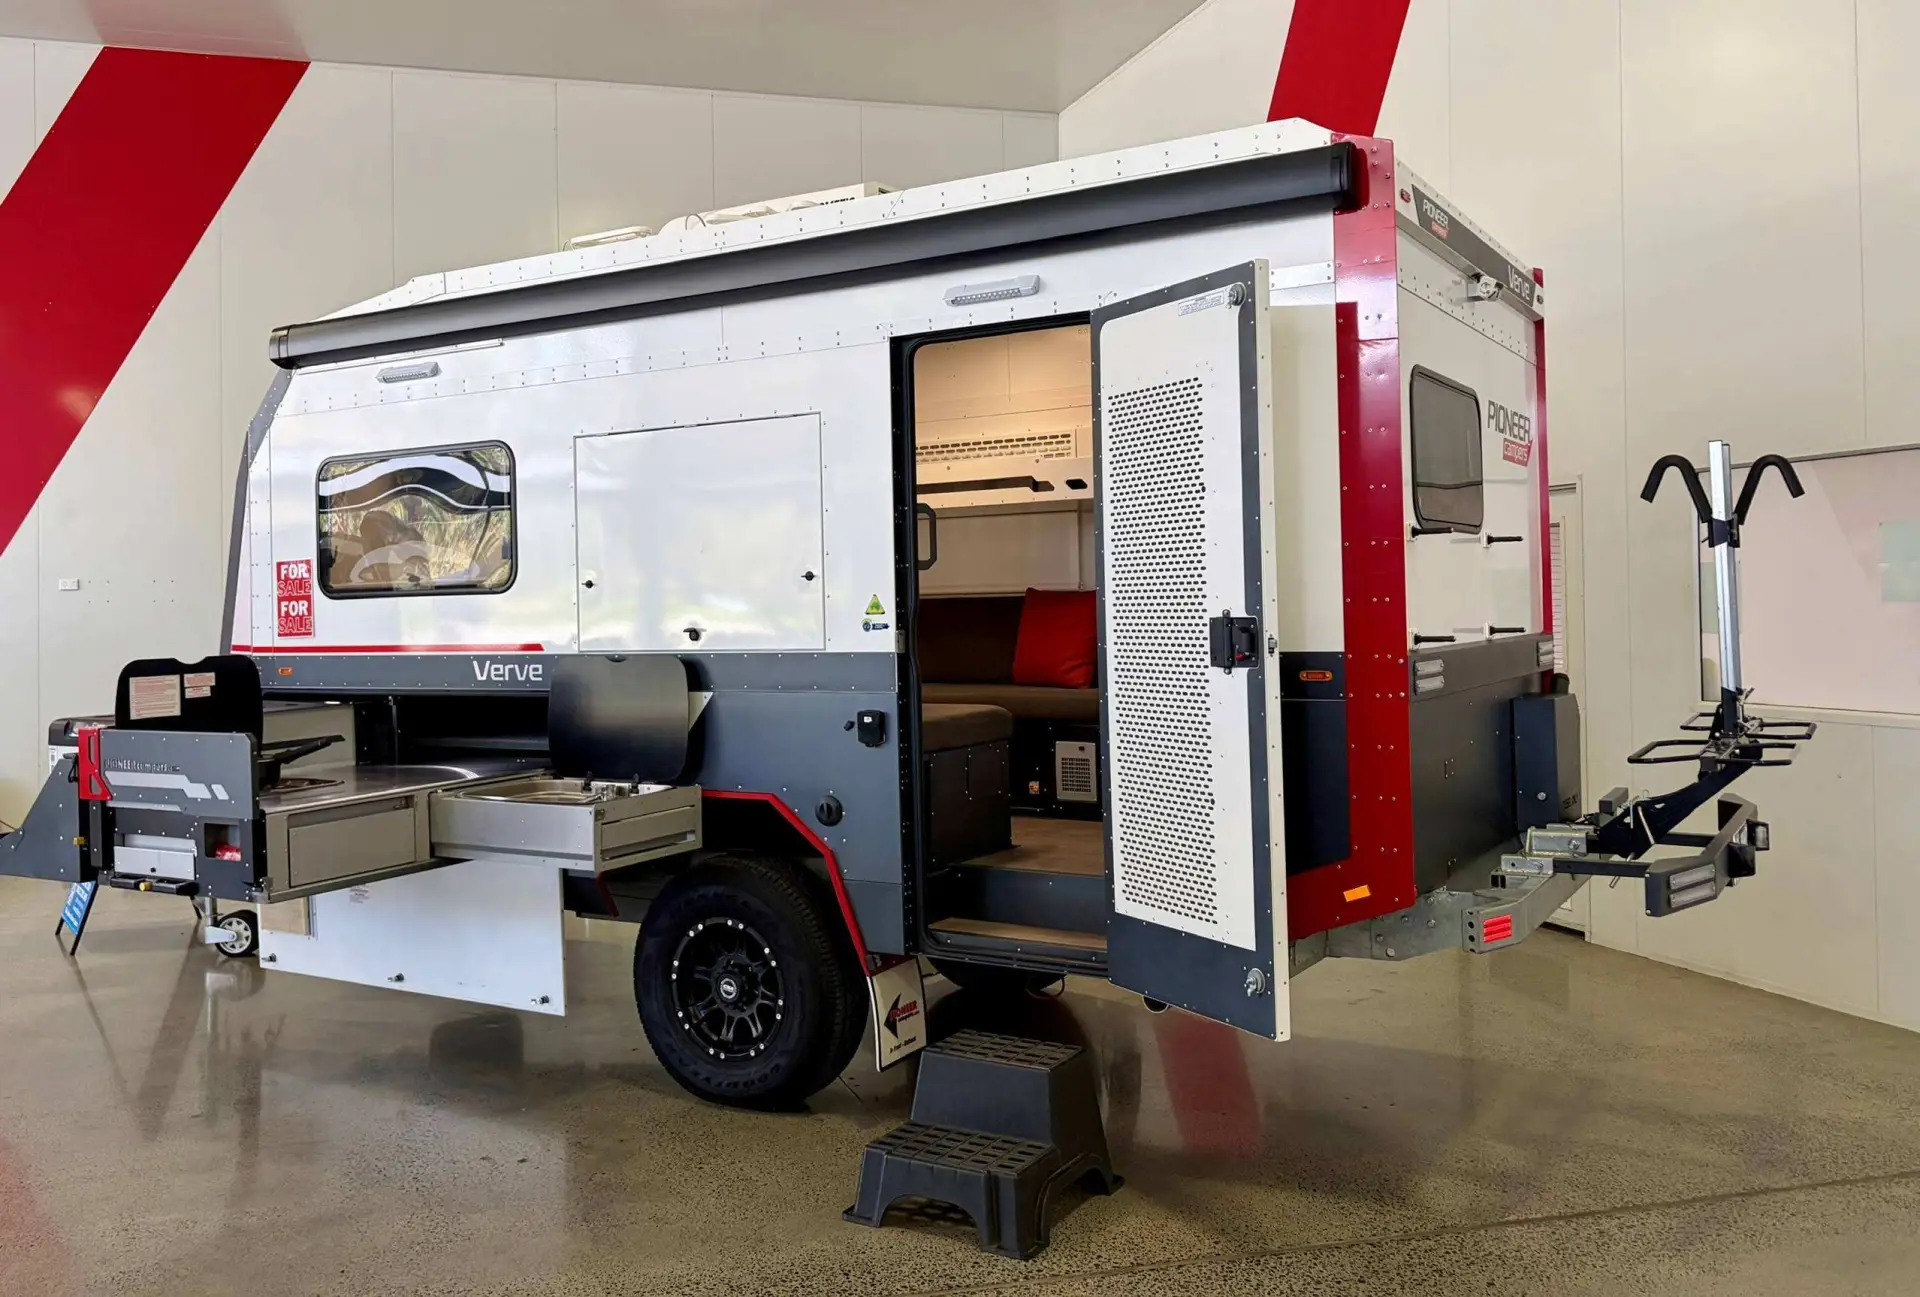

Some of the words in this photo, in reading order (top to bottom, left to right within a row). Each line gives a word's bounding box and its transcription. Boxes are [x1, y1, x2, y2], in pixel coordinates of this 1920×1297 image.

[1423, 199, 1449, 230] PIONEER
[1508, 264, 1530, 300] Verve
[1487, 400, 1531, 444] PIONEER
[1504, 441, 1529, 462] campers
[280, 563, 310, 580] FOR
[277, 579, 312, 597] SALE
[280, 600, 309, 617] FOR
[278, 616, 313, 634] SALE
[472, 660, 543, 681] Verve
